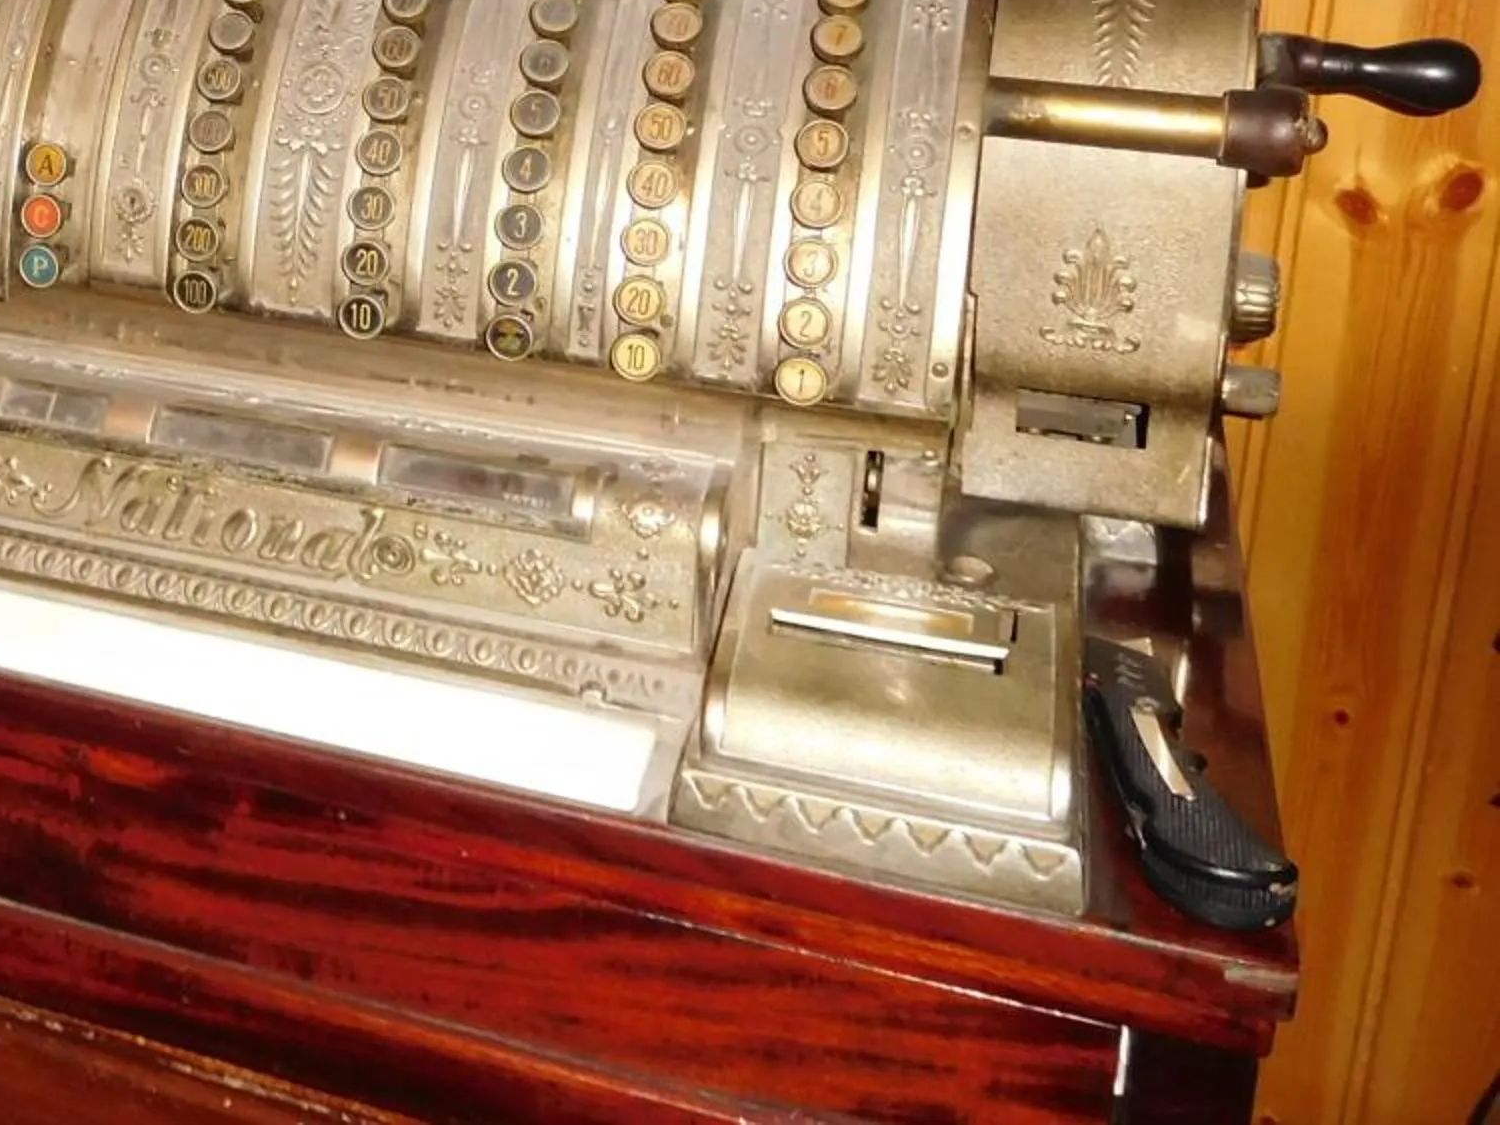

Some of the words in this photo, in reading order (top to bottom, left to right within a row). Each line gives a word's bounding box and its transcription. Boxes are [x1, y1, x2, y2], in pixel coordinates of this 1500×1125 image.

[649, 113, 674, 141] 50
[366, 138, 391, 166] 40
[815, 130, 831, 157] 5
[37, 154, 54, 176] A
[518, 152, 534, 182] 4
[641, 171, 669, 199] 40
[360, 194, 383, 221] 30
[513, 211, 528, 239] 3
[184, 227, 211, 252] 200
[633, 227, 659, 256] 30
[31, 255, 49, 278] P
[355, 250, 378, 276] 20
[802, 249, 818, 278] 3
[183, 279, 207, 304] 100
[506, 267, 521, 297] 2
[626, 286, 651, 316] 20
[350, 303, 372, 330] 10
[799, 309, 813, 338] 2
[626, 343, 646, 371] 10
[31, 457, 390, 586] National
